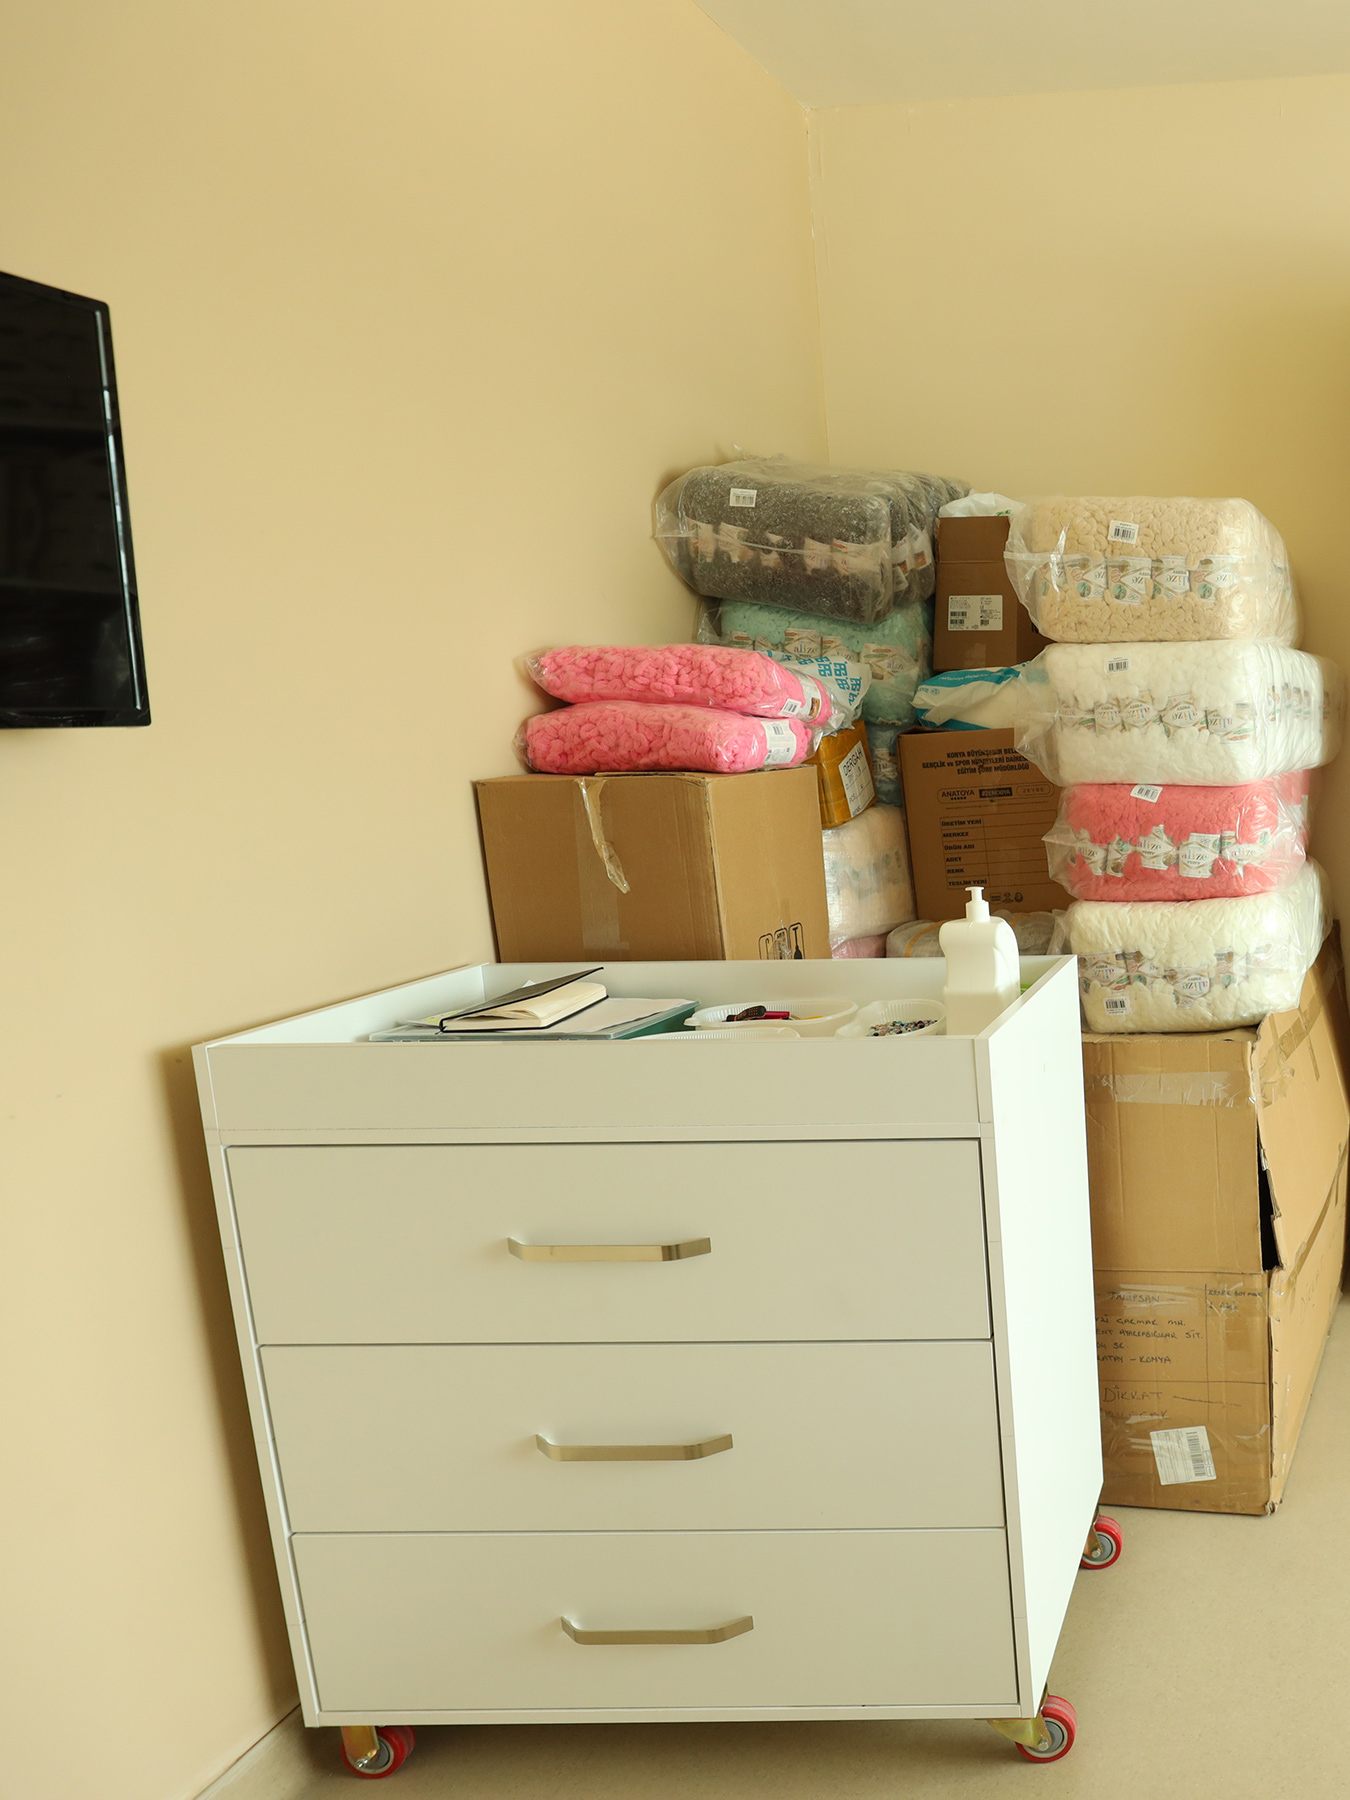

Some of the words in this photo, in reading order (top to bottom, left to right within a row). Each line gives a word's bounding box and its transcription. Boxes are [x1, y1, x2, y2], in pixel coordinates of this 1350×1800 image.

[793, 644, 818, 654] alize
[1125, 706, 1151, 719] alize
[1172, 709, 1198, 722] alize
[1207, 716, 1233, 731] alize
[946, 750, 965, 759] KONYA
[922, 760, 946, 770] GENÇLİK
[954, 759, 970, 767] SPOR
[957, 766, 976, 775] EĞİTİM
[993, 763, 1030, 772] MÜDÜRLÜĞÜ
[941, 788, 975, 798] ANATOYA
[941, 819, 966, 827] ÜRETİM
[1136, 838, 1162, 850] alize
[1077, 846, 1098, 858] alize
[1181, 849, 1209, 861] alize
[1232, 845, 1257, 858] alize
[1092, 968, 1115, 979] alize
[1182, 980, 1209, 992] alize
[1139, 1355, 1172, 1364] KONYA
[1104, 1385, 1163, 1403] DİKKAT
